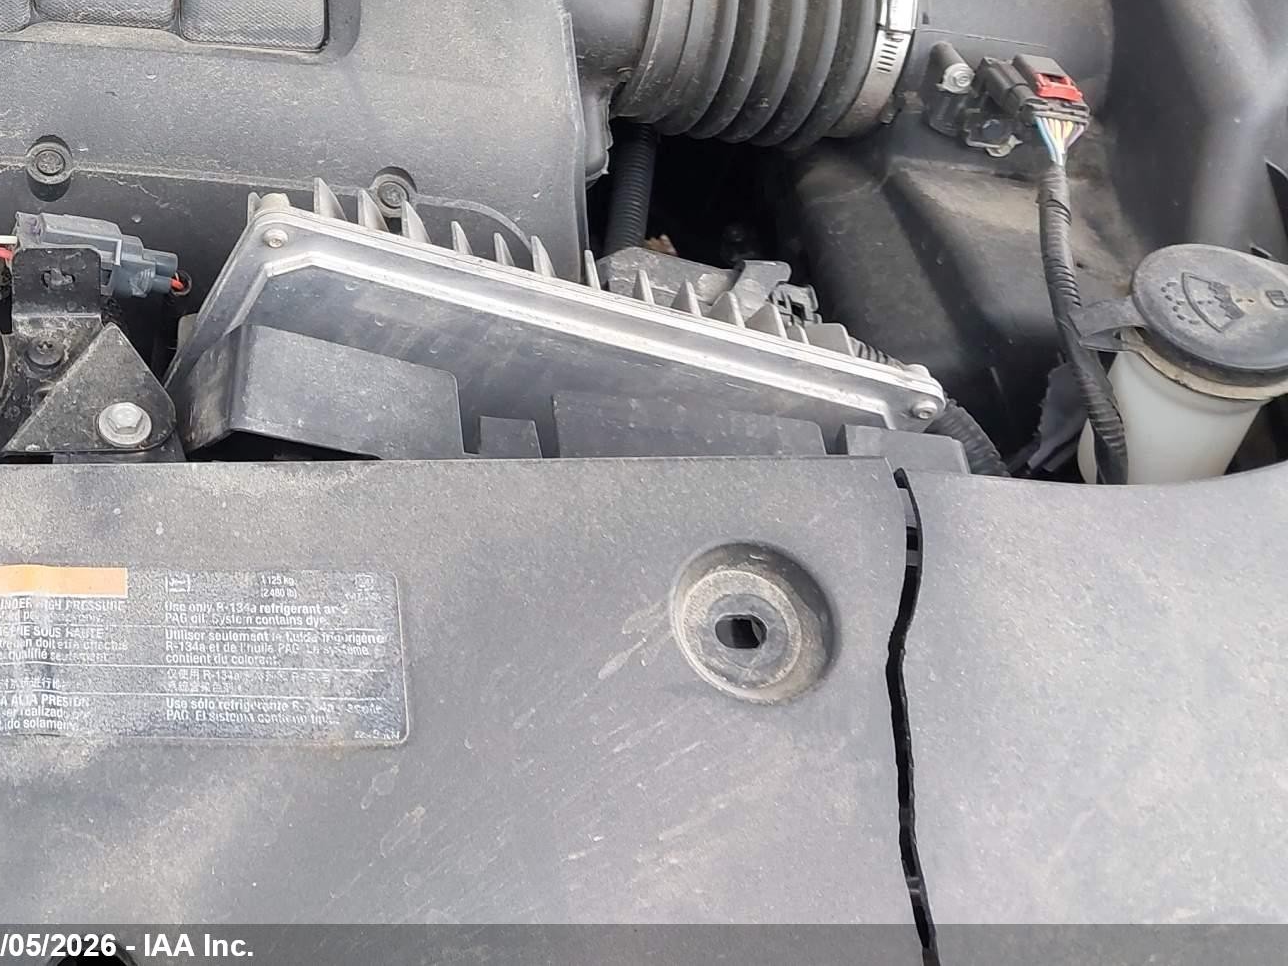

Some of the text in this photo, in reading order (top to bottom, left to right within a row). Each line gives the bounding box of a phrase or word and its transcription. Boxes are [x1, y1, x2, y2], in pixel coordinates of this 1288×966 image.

[189, 602, 212, 614] only
[216, 602, 257, 613] R-134a
[259, 603, 321, 616] refrigerant
[165, 612, 188, 624] PAG
[255, 614, 303, 626] contains
[33, 625, 62, 638] SOUS
[165, 629, 205, 641] Utiliser
[208, 631, 269, 642] seulement
[35, 637, 55, 650] doit
[165, 641, 206, 652] R-134a
[223, 642, 237, 653] de
[165, 653, 211, 664] contient
[166, 697, 188, 709] Use
[190, 697, 215, 710] sólo
